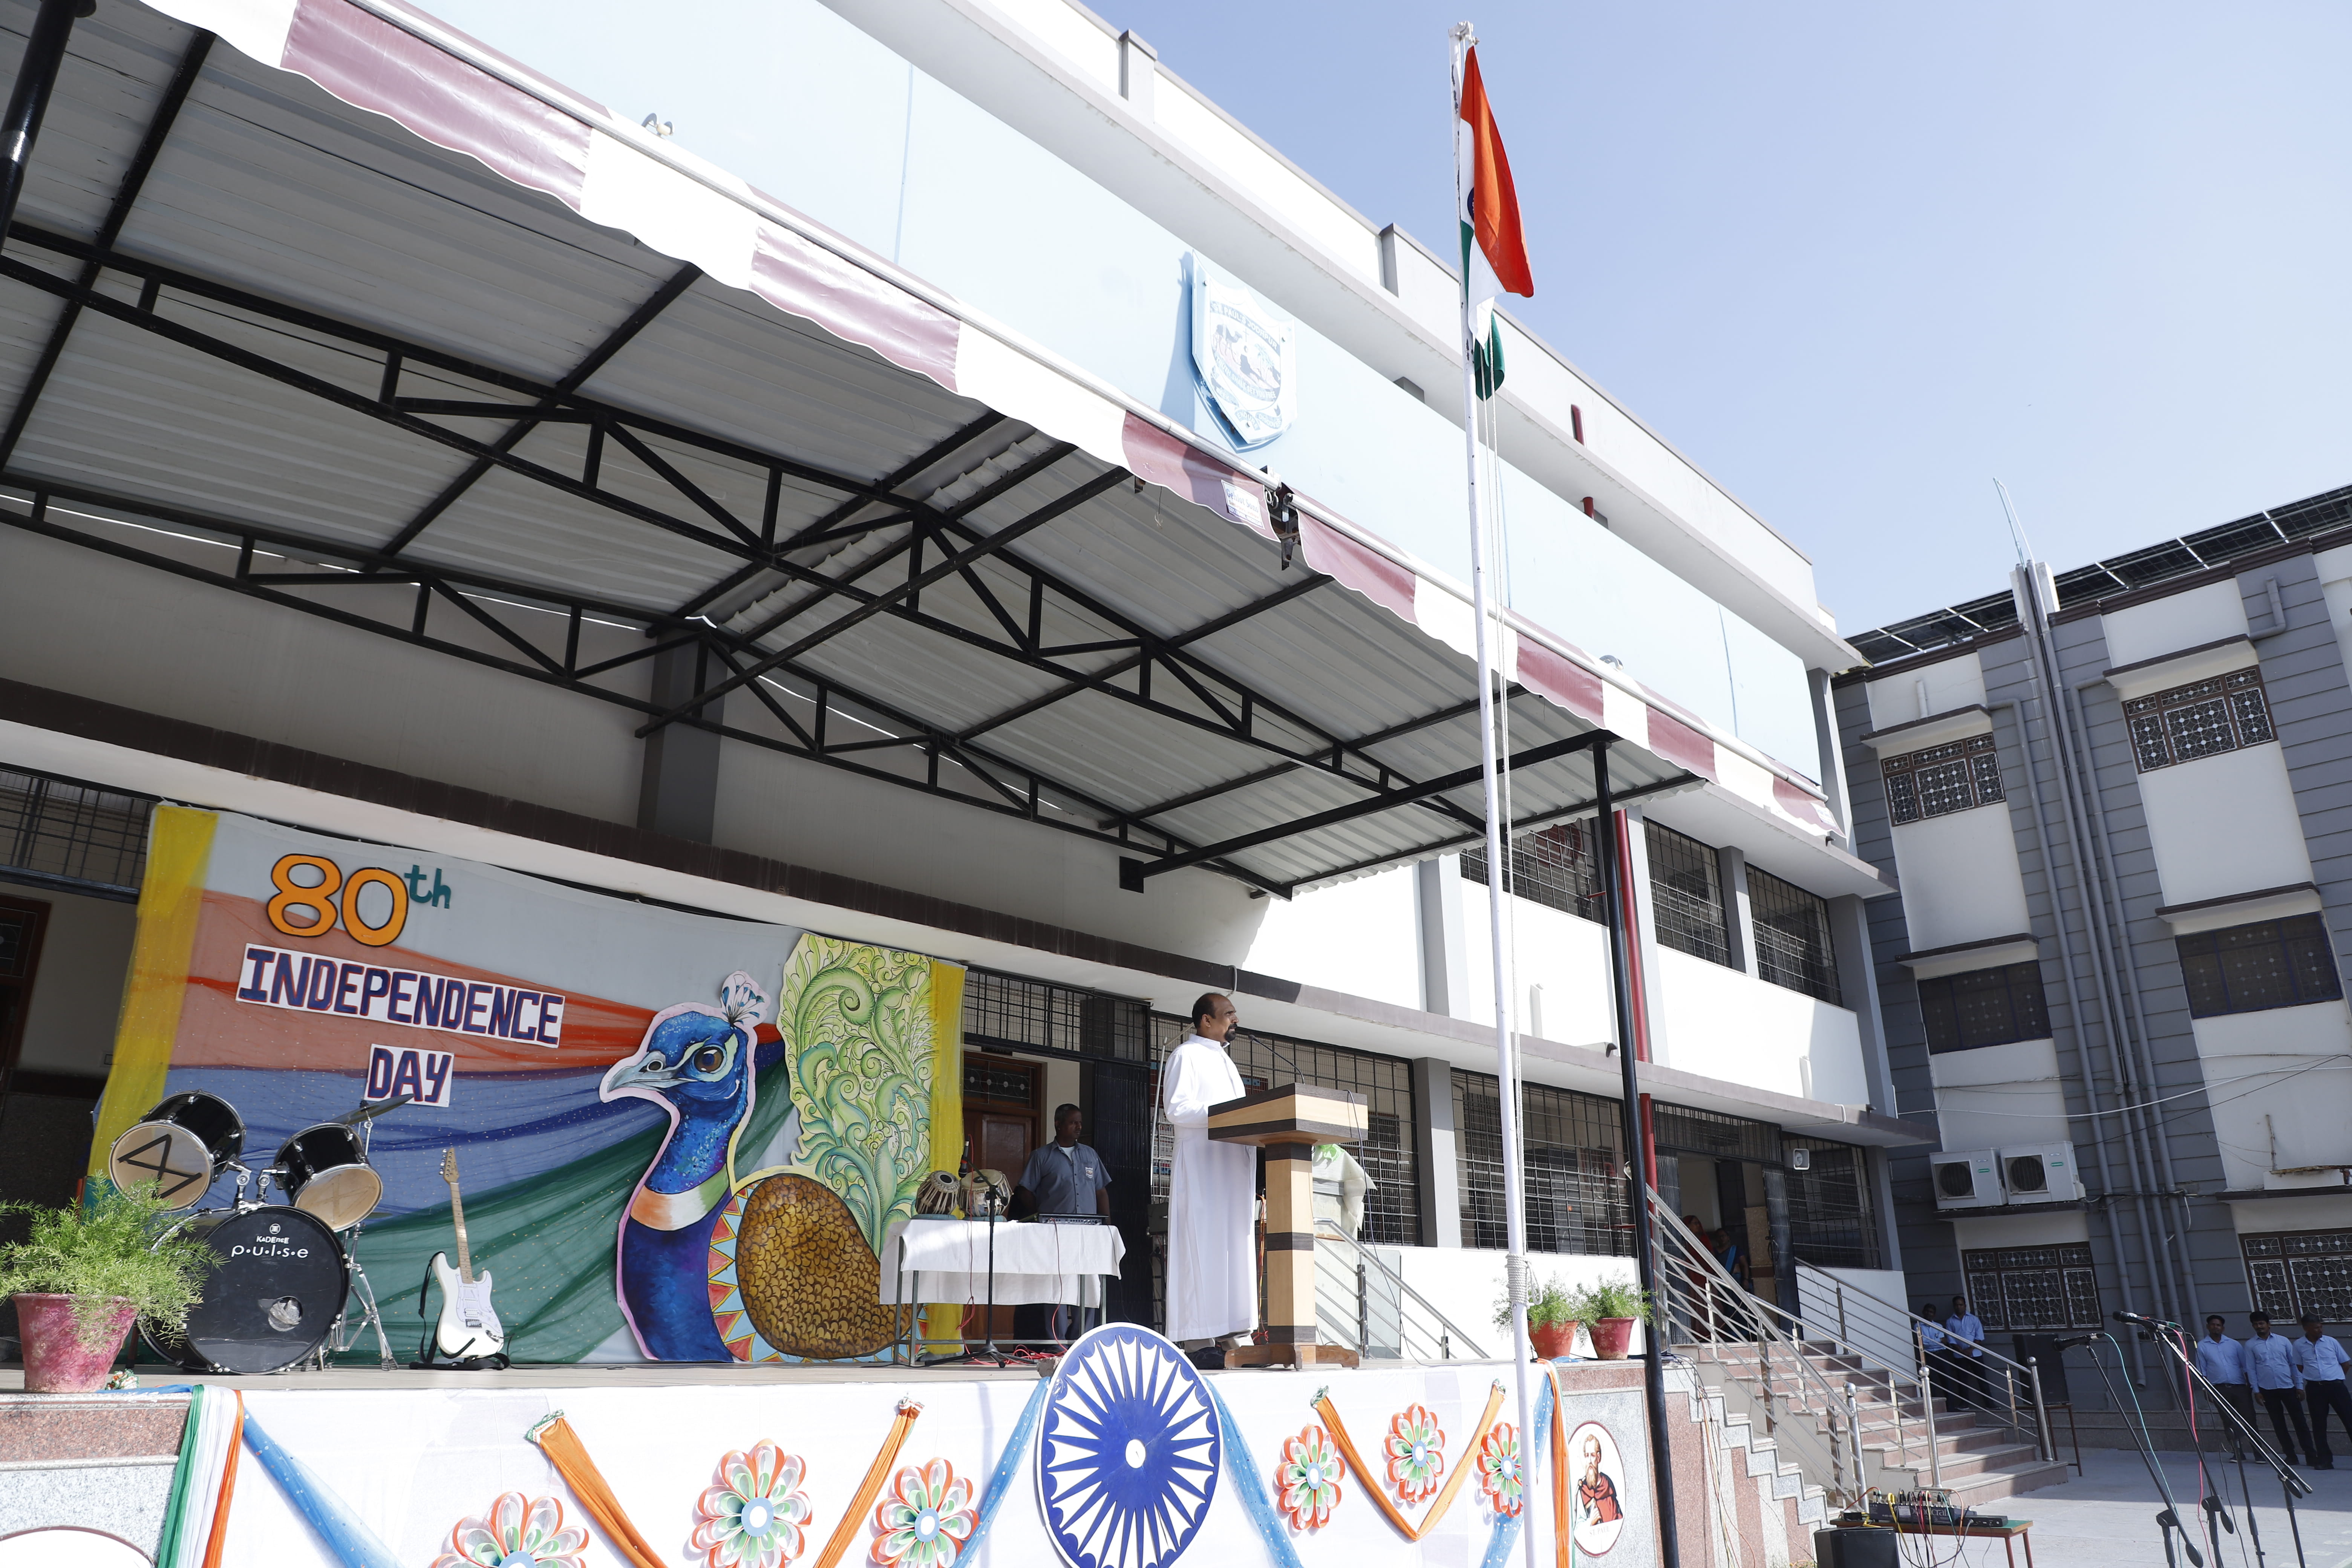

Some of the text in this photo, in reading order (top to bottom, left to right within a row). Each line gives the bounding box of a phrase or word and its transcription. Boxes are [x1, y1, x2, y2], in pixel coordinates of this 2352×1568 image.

[1211, 303, 1277, 350] ST. PAUL'S JODHPUR
[1216, 358, 1231, 376] TRUTH
[1231, 374, 1246, 390] SHALL
[1237, 412, 1258, 429] ENDURE
[1226, 488, 1245, 505] Gehlot
[1245, 499, 1258, 513] Sons
[267, 853, 452, 947] 80th
[239, 948, 564, 1044] INDEPENDENCE
[368, 1047, 452, 1103] DAY
[1597, 1525, 1610, 1534] PAUL
